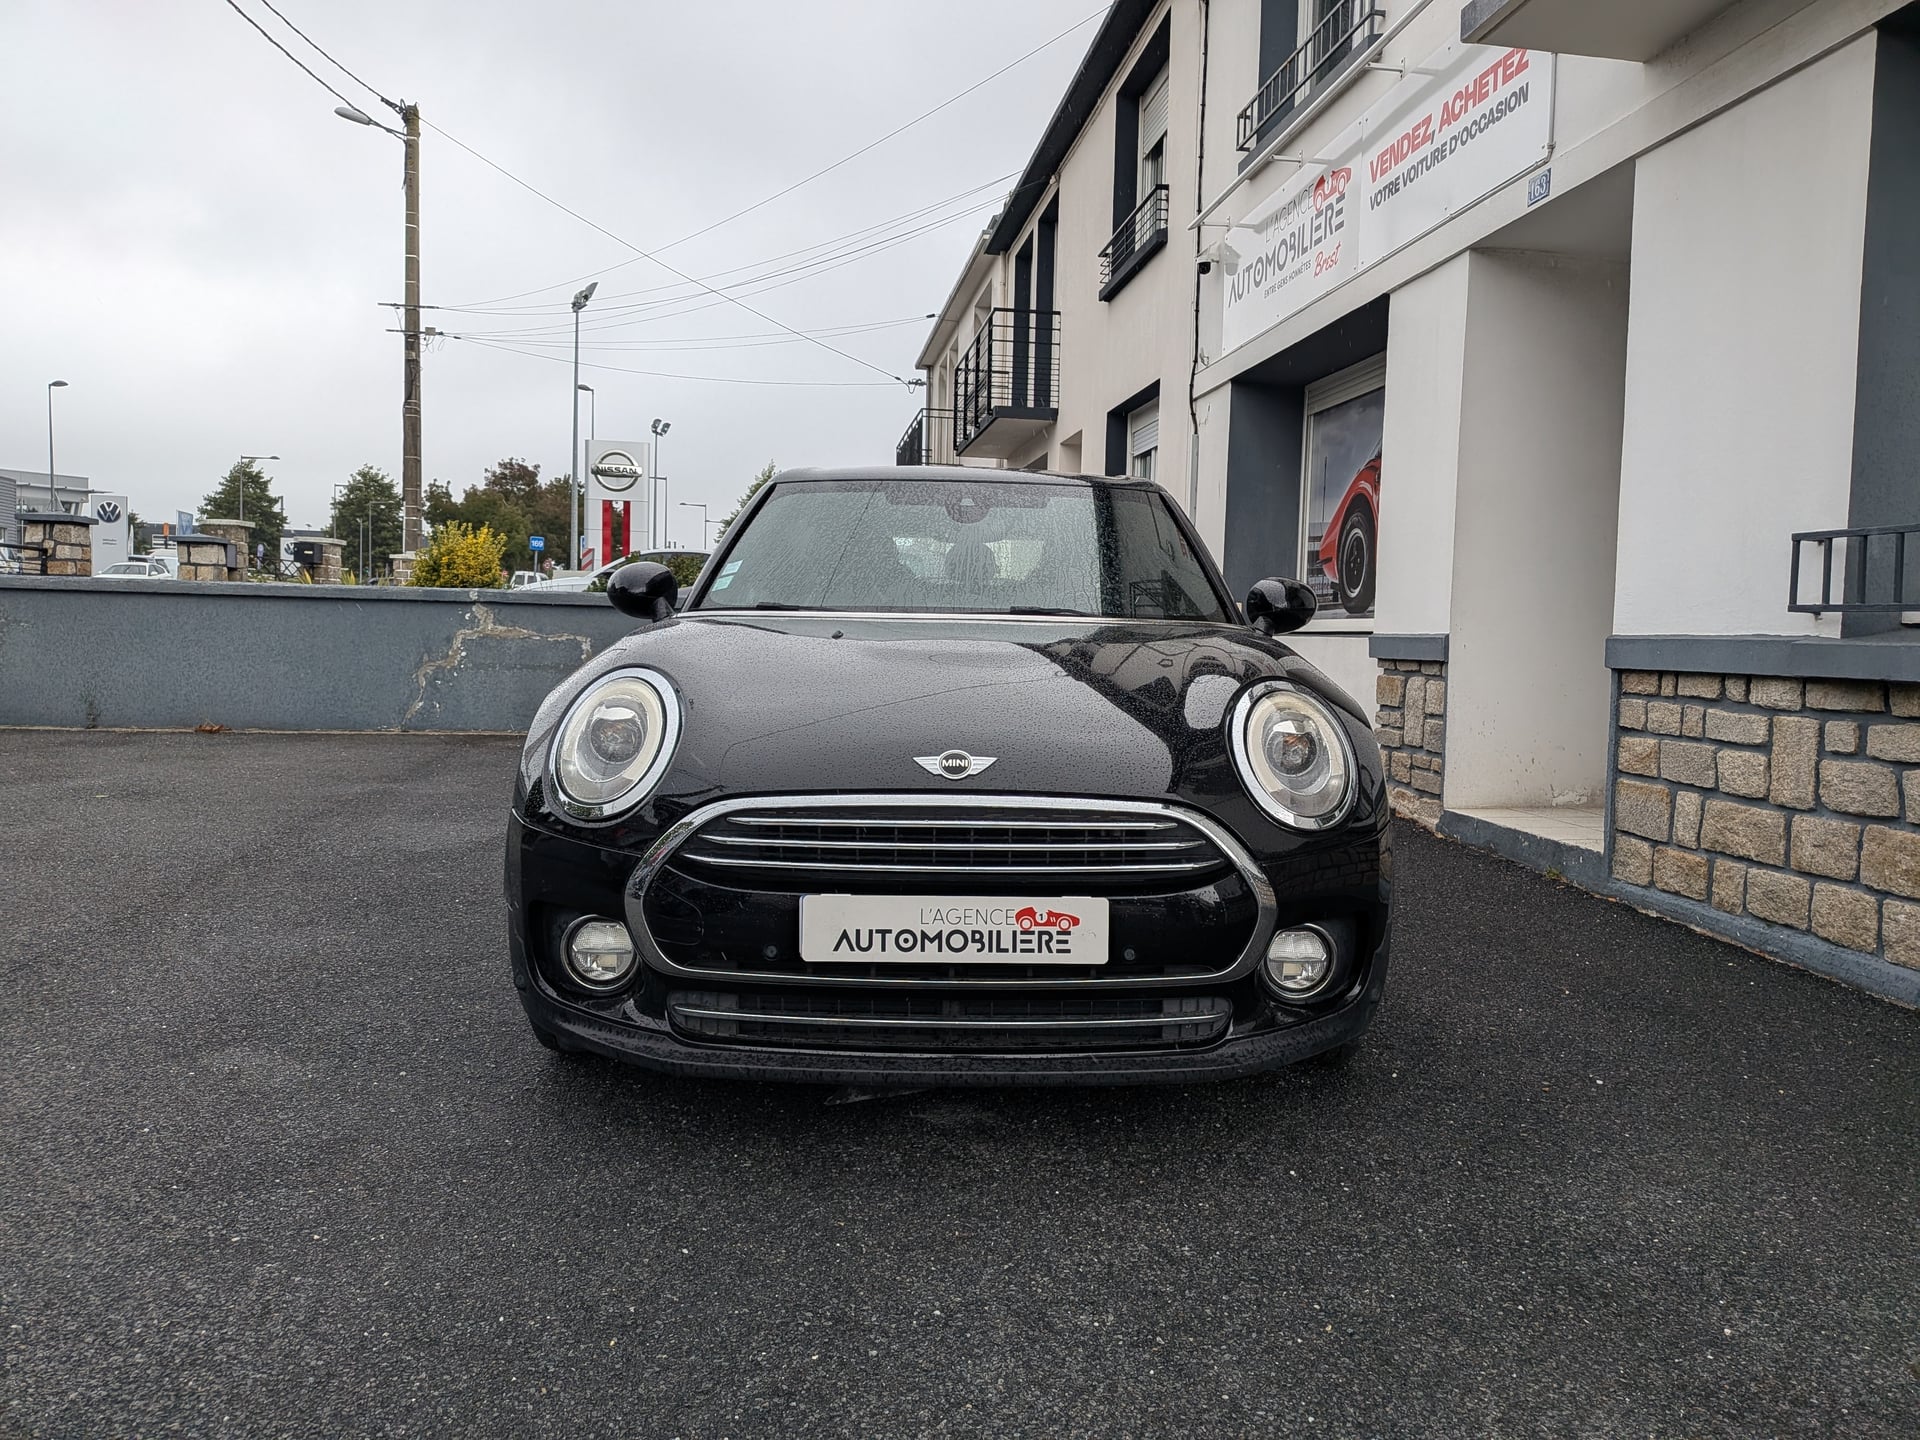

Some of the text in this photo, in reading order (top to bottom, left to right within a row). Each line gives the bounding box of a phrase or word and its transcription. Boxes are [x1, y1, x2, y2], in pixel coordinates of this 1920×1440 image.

[1369, 48, 1530, 184] VENDEZ, ACHETEZ
[1370, 81, 1530, 211] VOTRE VOITURE D'OCCASION
[1531, 175, 1547, 200] 163
[1265, 182, 1315, 243] L'AGENCE
[1313, 241, 1342, 279] Brest
[1264, 283, 1277, 299] ENTRE
[1277, 275, 1289, 290] GENS
[597, 465, 637, 475] NISSAN
[942, 759, 969, 768] MINI
[919, 907, 1016, 926] L'AGENCE
